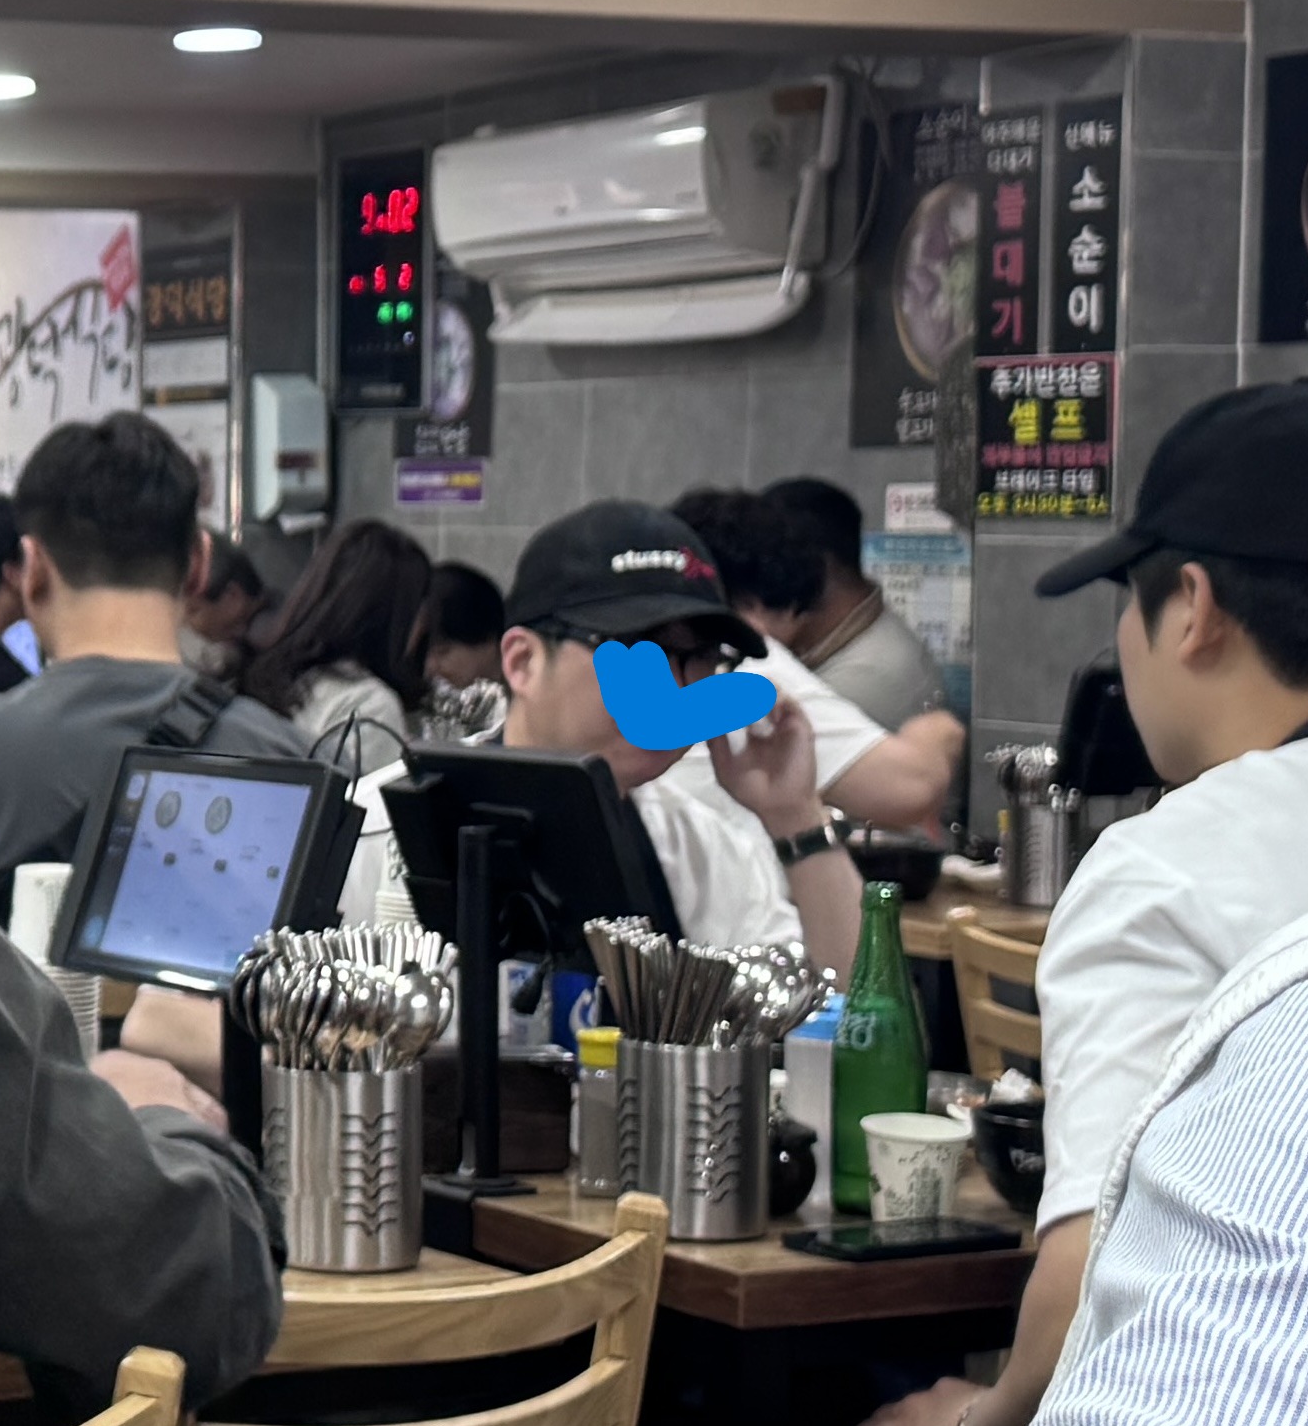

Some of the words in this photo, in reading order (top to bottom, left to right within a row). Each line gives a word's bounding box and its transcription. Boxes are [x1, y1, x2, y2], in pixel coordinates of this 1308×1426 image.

[1068, 164, 1108, 335] 소순이
[990, 361, 1102, 400] 추가반찬은
[1009, 399, 1085, 445] 셀프
